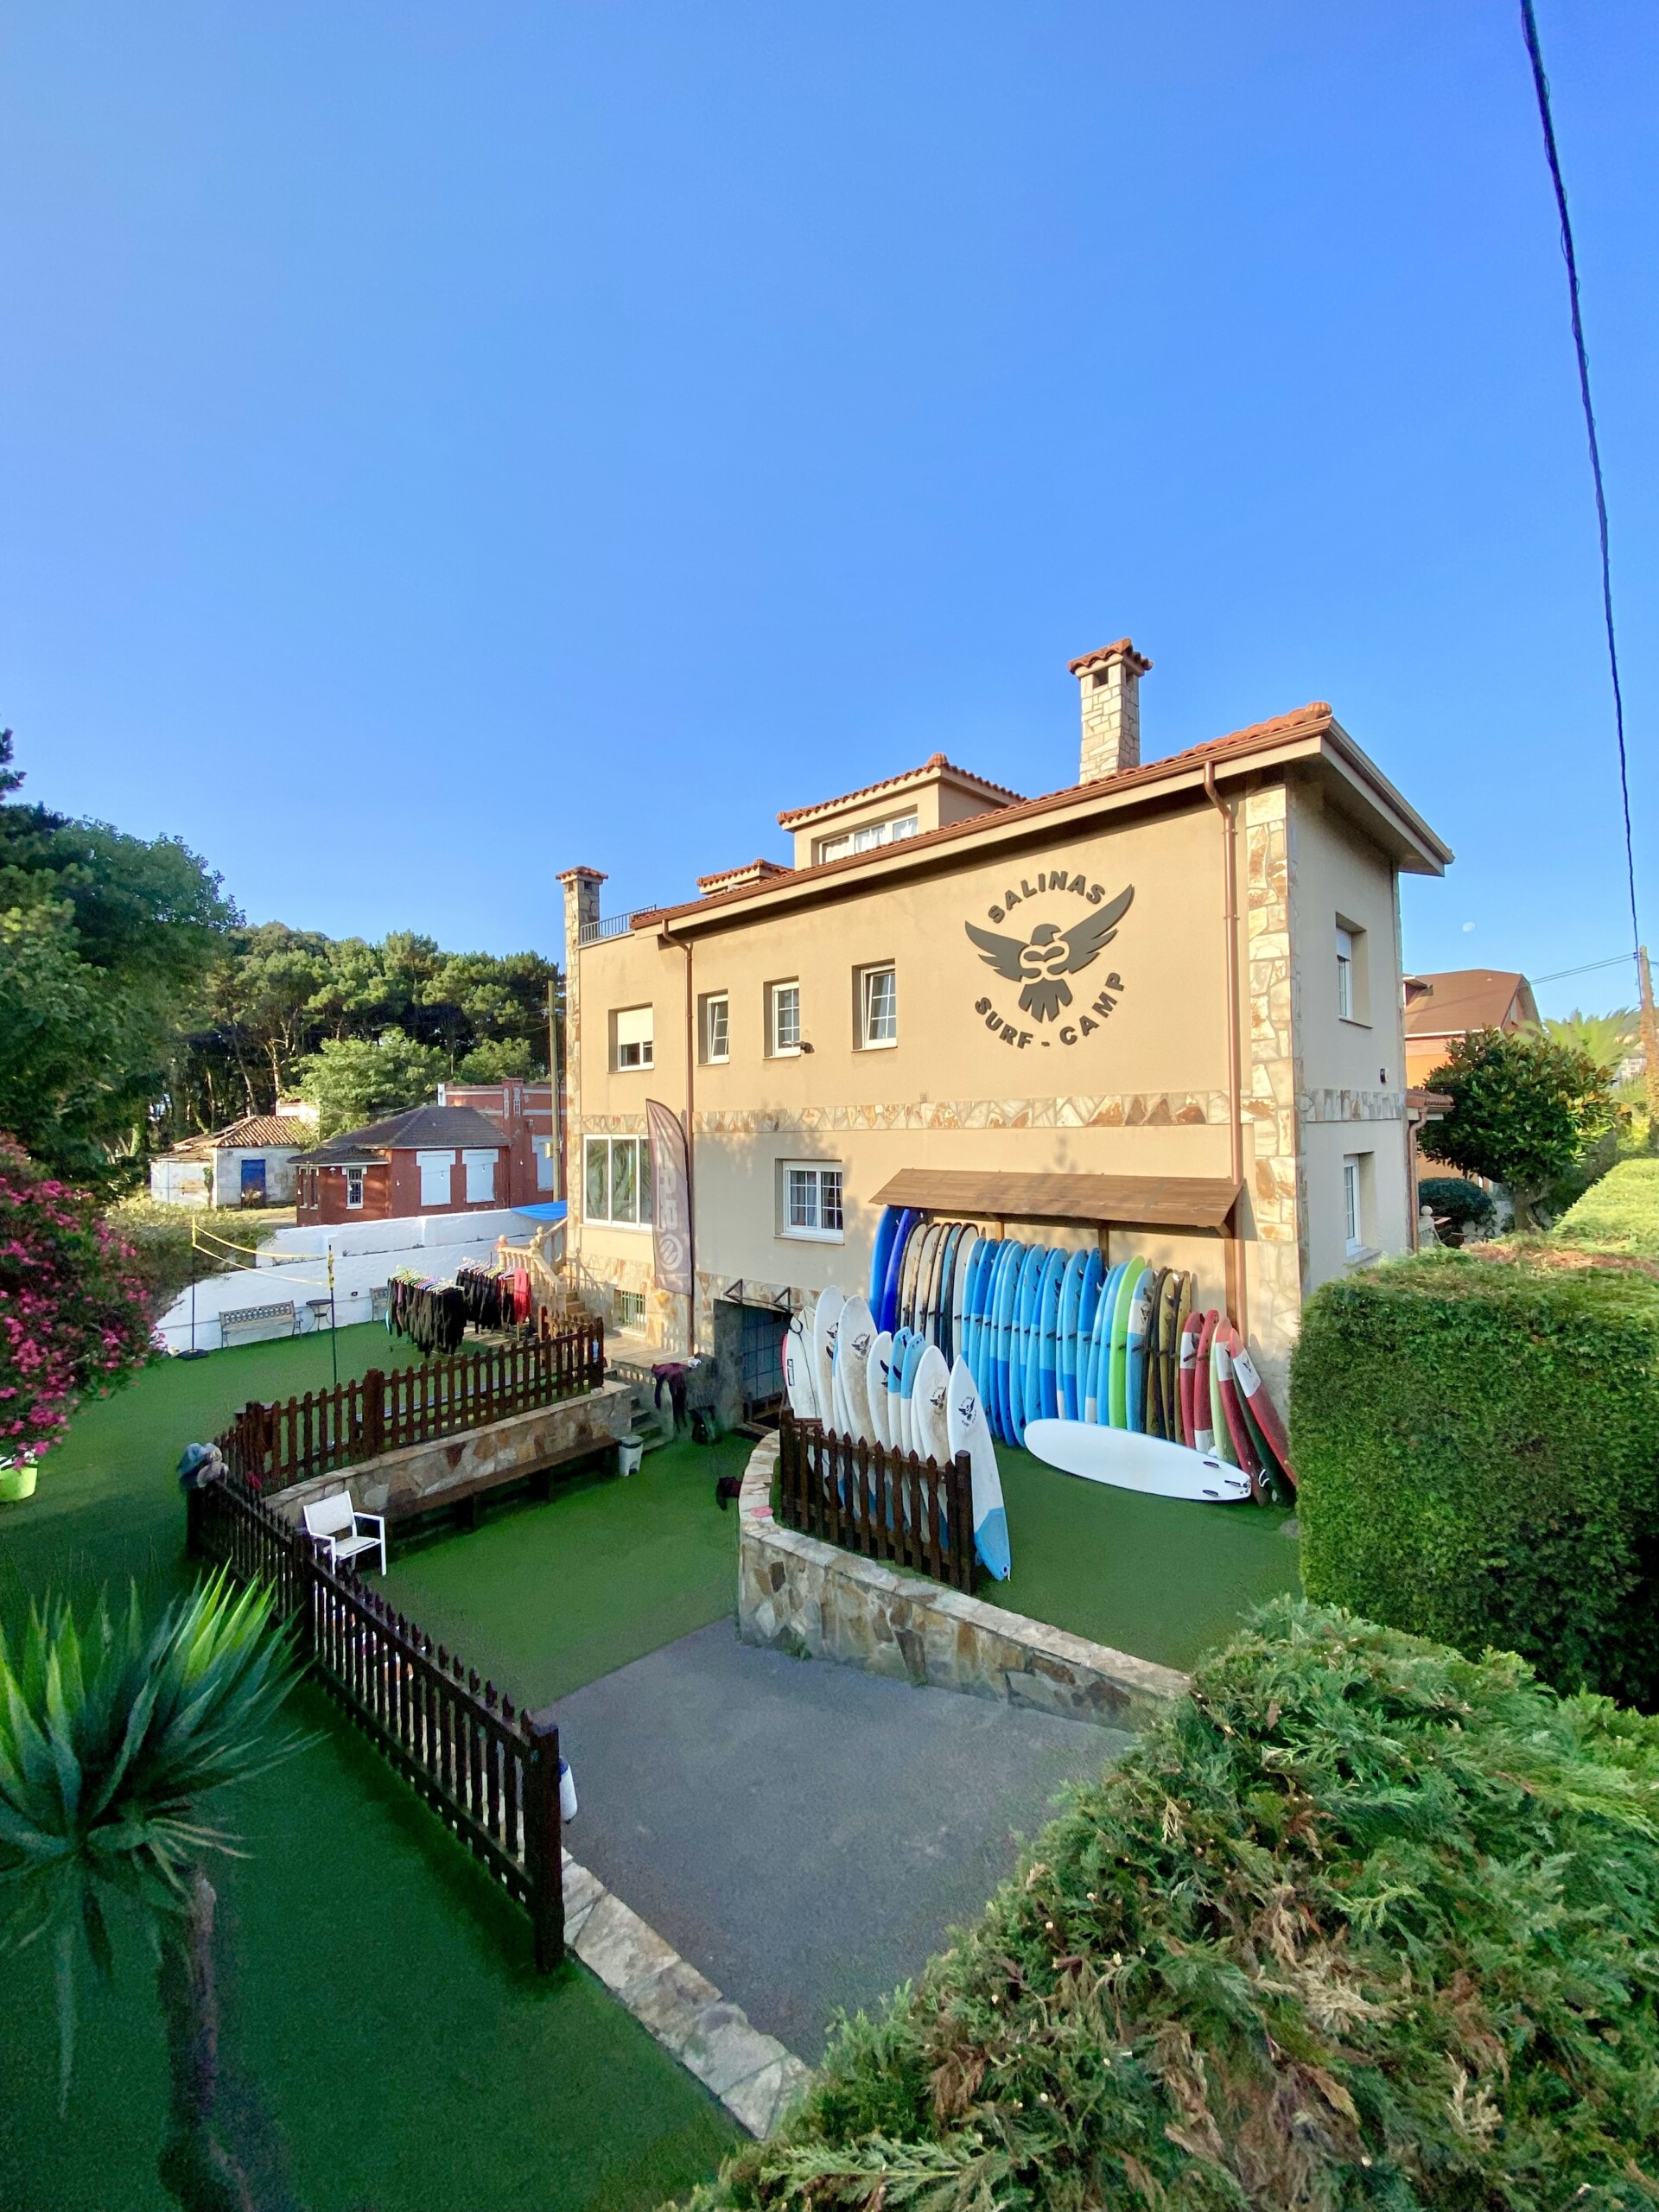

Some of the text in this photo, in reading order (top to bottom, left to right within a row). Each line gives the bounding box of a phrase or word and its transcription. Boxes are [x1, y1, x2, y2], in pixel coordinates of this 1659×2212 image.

[988, 870, 1106, 924] SALINAS
[975, 997, 1033, 1049] SURF
[1059, 972, 1125, 1046] CAMP
